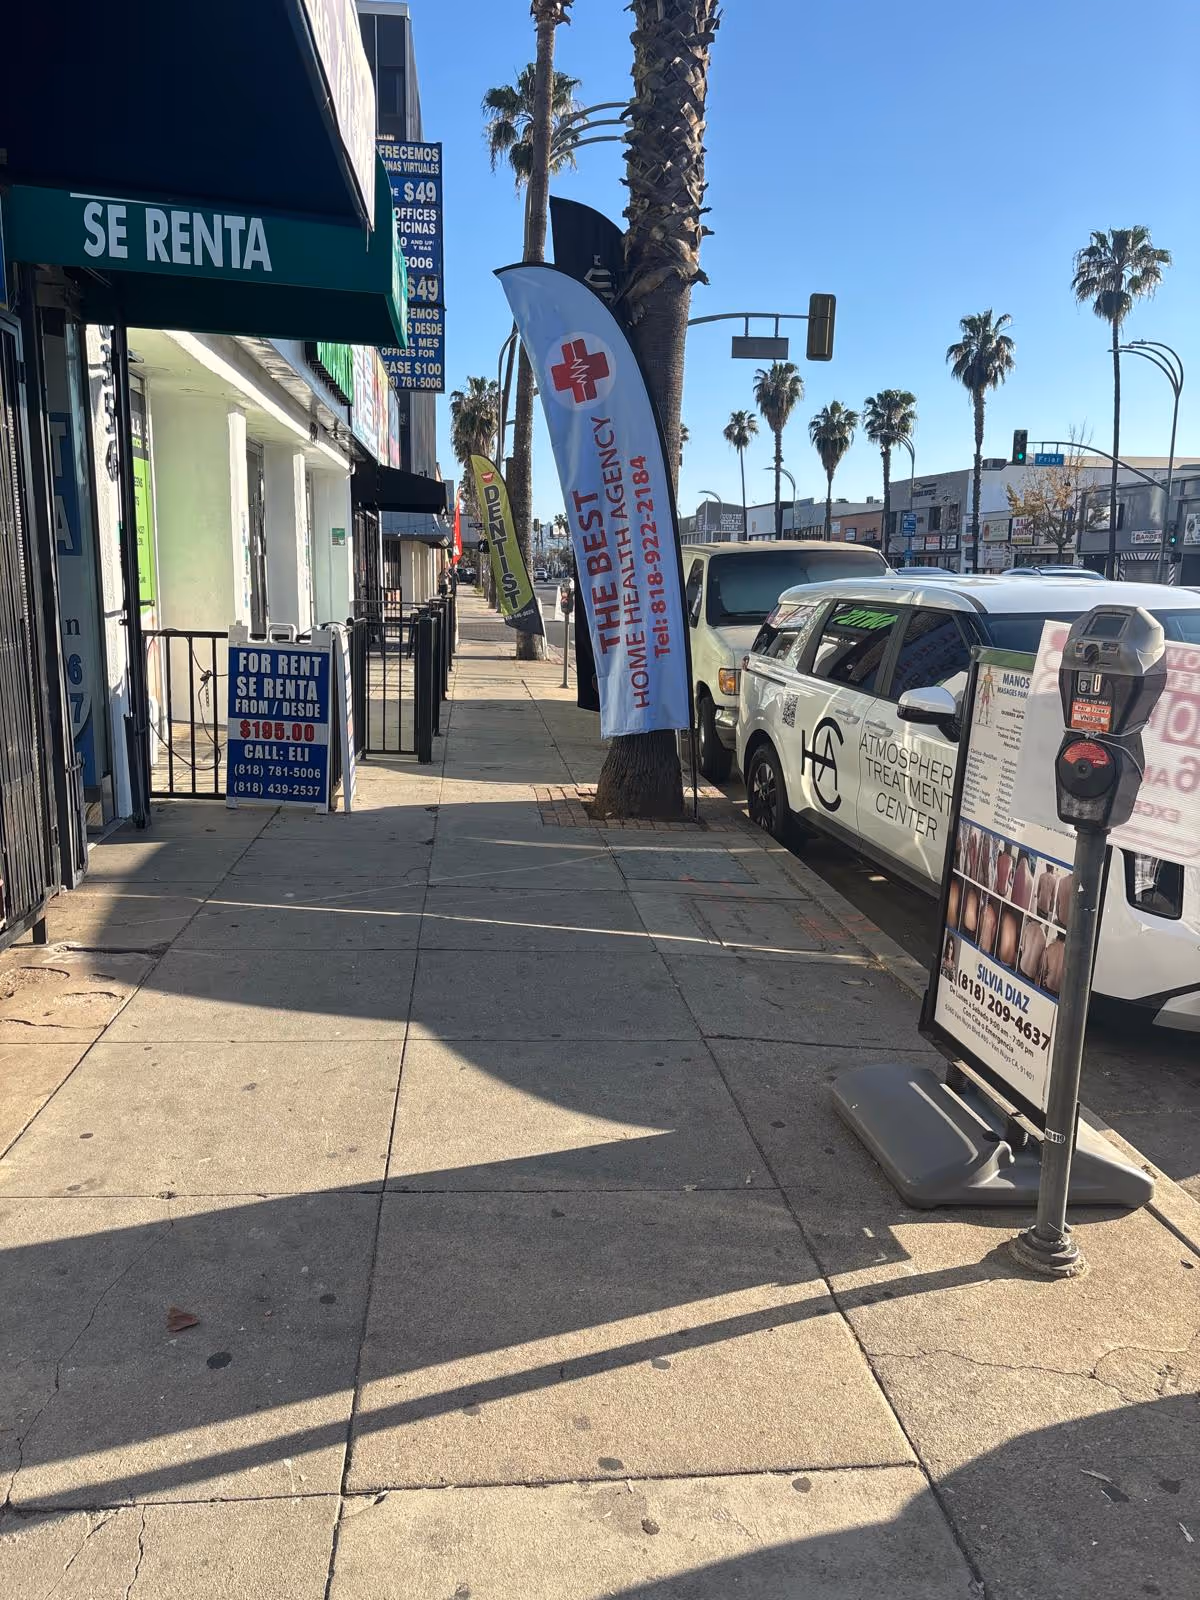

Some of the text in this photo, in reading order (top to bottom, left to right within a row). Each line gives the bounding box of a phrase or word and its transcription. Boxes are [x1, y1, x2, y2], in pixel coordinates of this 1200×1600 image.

[377, 145, 439, 162] FRECEMOS
[403, 162, 440, 175] VIRTUALES
[404, 181, 438, 204] $49
[395, 207, 437, 220] OFFICES
[84, 201, 272, 272] SE RENTA
[407, 278, 439, 302] $49
[415, 323, 442, 336] DESDE
[382, 347, 435, 358] OFFICES FOR
[419, 338, 439, 349] MES
[415, 361, 441, 376] $100
[401, 376, 442, 389] 781-5006
[483, 484, 521, 610] DENTIST
[630, 455, 670, 659] Tel: 818-922-2184
[572, 489, 621, 654] THE BEST
[590, 415, 650, 709] HOME HEALTH AGENCY
[239, 652, 321, 677] FOR RENT
[237, 676, 318, 701] SE RENTA
[1002, 673, 1030, 689] MANOS
[235, 699, 320, 718] FROM / DESDE
[239, 719, 315, 742] $195.00
[244, 744, 309, 762] CALL: ELI
[234, 763, 321, 779] (818) 781-5006
[234, 781, 320, 796] (818) 439-2537
[865, 756, 953, 816] TREATMENT
[876, 792, 937, 841] CENTER
[977, 963, 1030, 1014] SILVIA DIAZ
[958, 969, 1051, 1051] (818) 209-4637
[963, 1007, 971, 1019] Con
[985, 1025, 1014, 1053] Emergencia
[1024, 1047, 1034, 1057] pm
